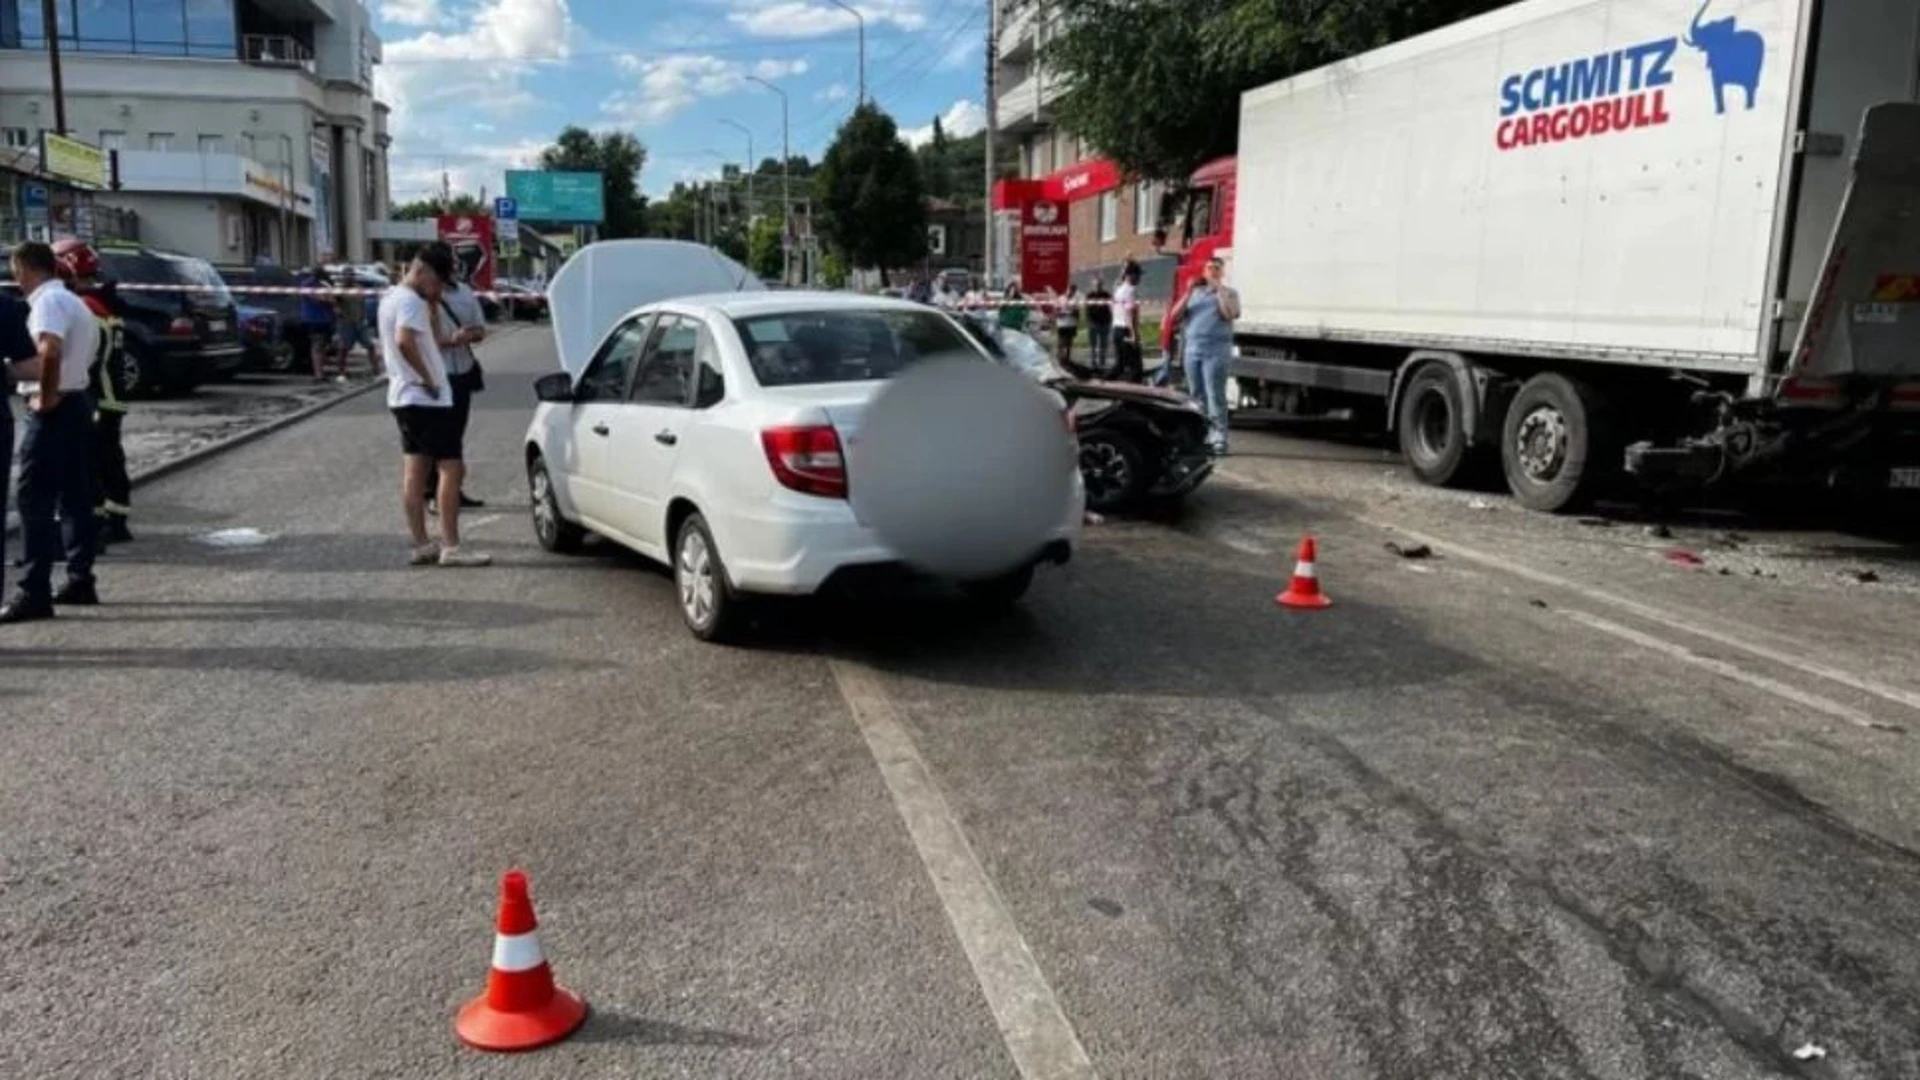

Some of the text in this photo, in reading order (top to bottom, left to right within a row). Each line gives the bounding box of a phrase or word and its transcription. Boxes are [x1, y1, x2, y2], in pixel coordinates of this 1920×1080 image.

[1500, 36, 1677, 116] SCHMITZ
[1497, 90, 1669, 150] CARGOBULL
[499, 199, 514, 217] P
